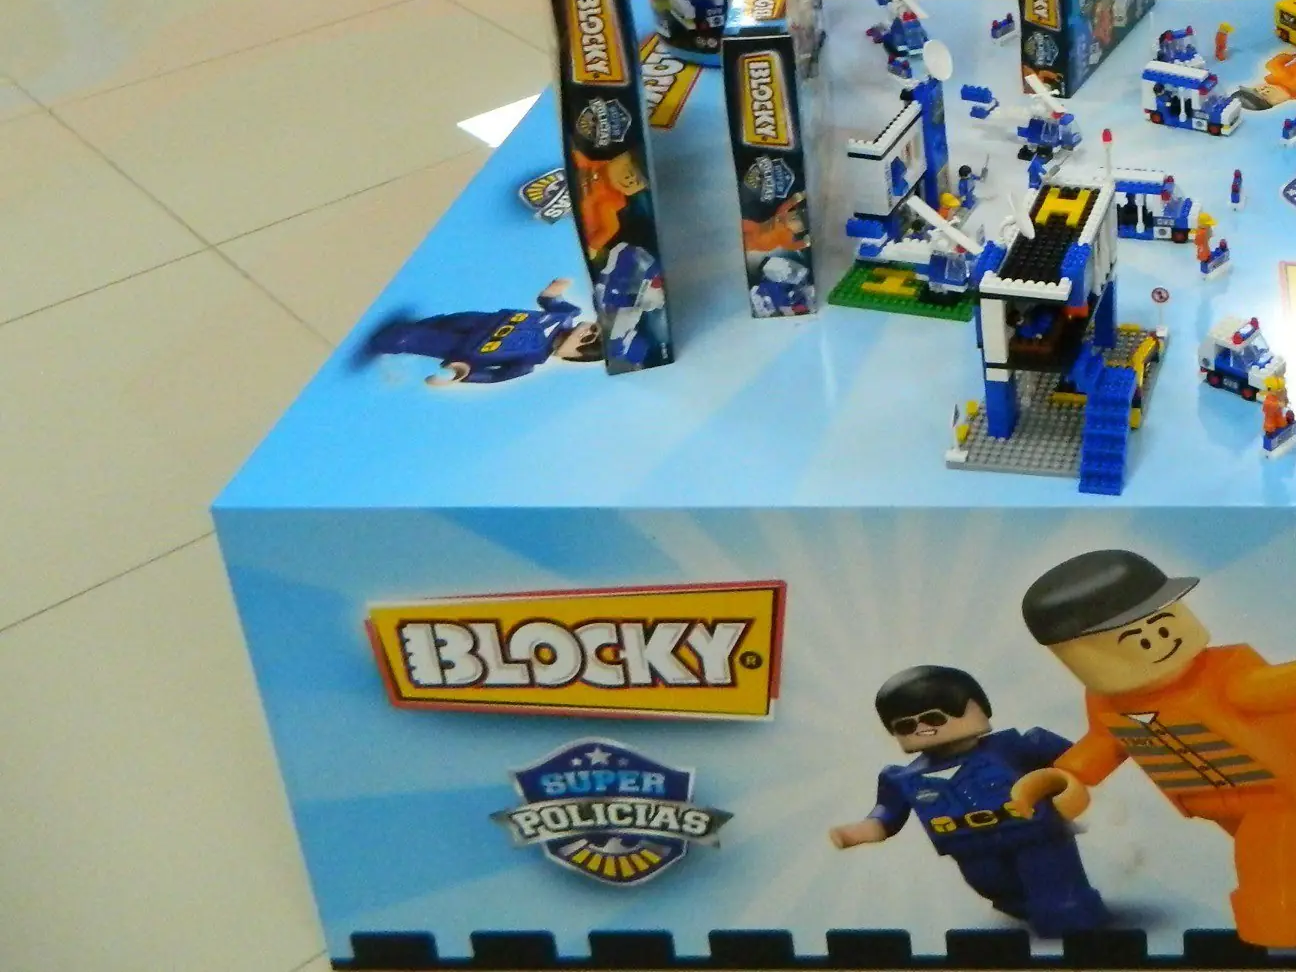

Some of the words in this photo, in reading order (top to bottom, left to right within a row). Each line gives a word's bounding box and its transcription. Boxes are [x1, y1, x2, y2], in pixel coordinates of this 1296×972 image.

[748, 61, 777, 139] BLOCKY
[400, 619, 753, 688] BLOCKY
[539, 769, 667, 796] SUPER
